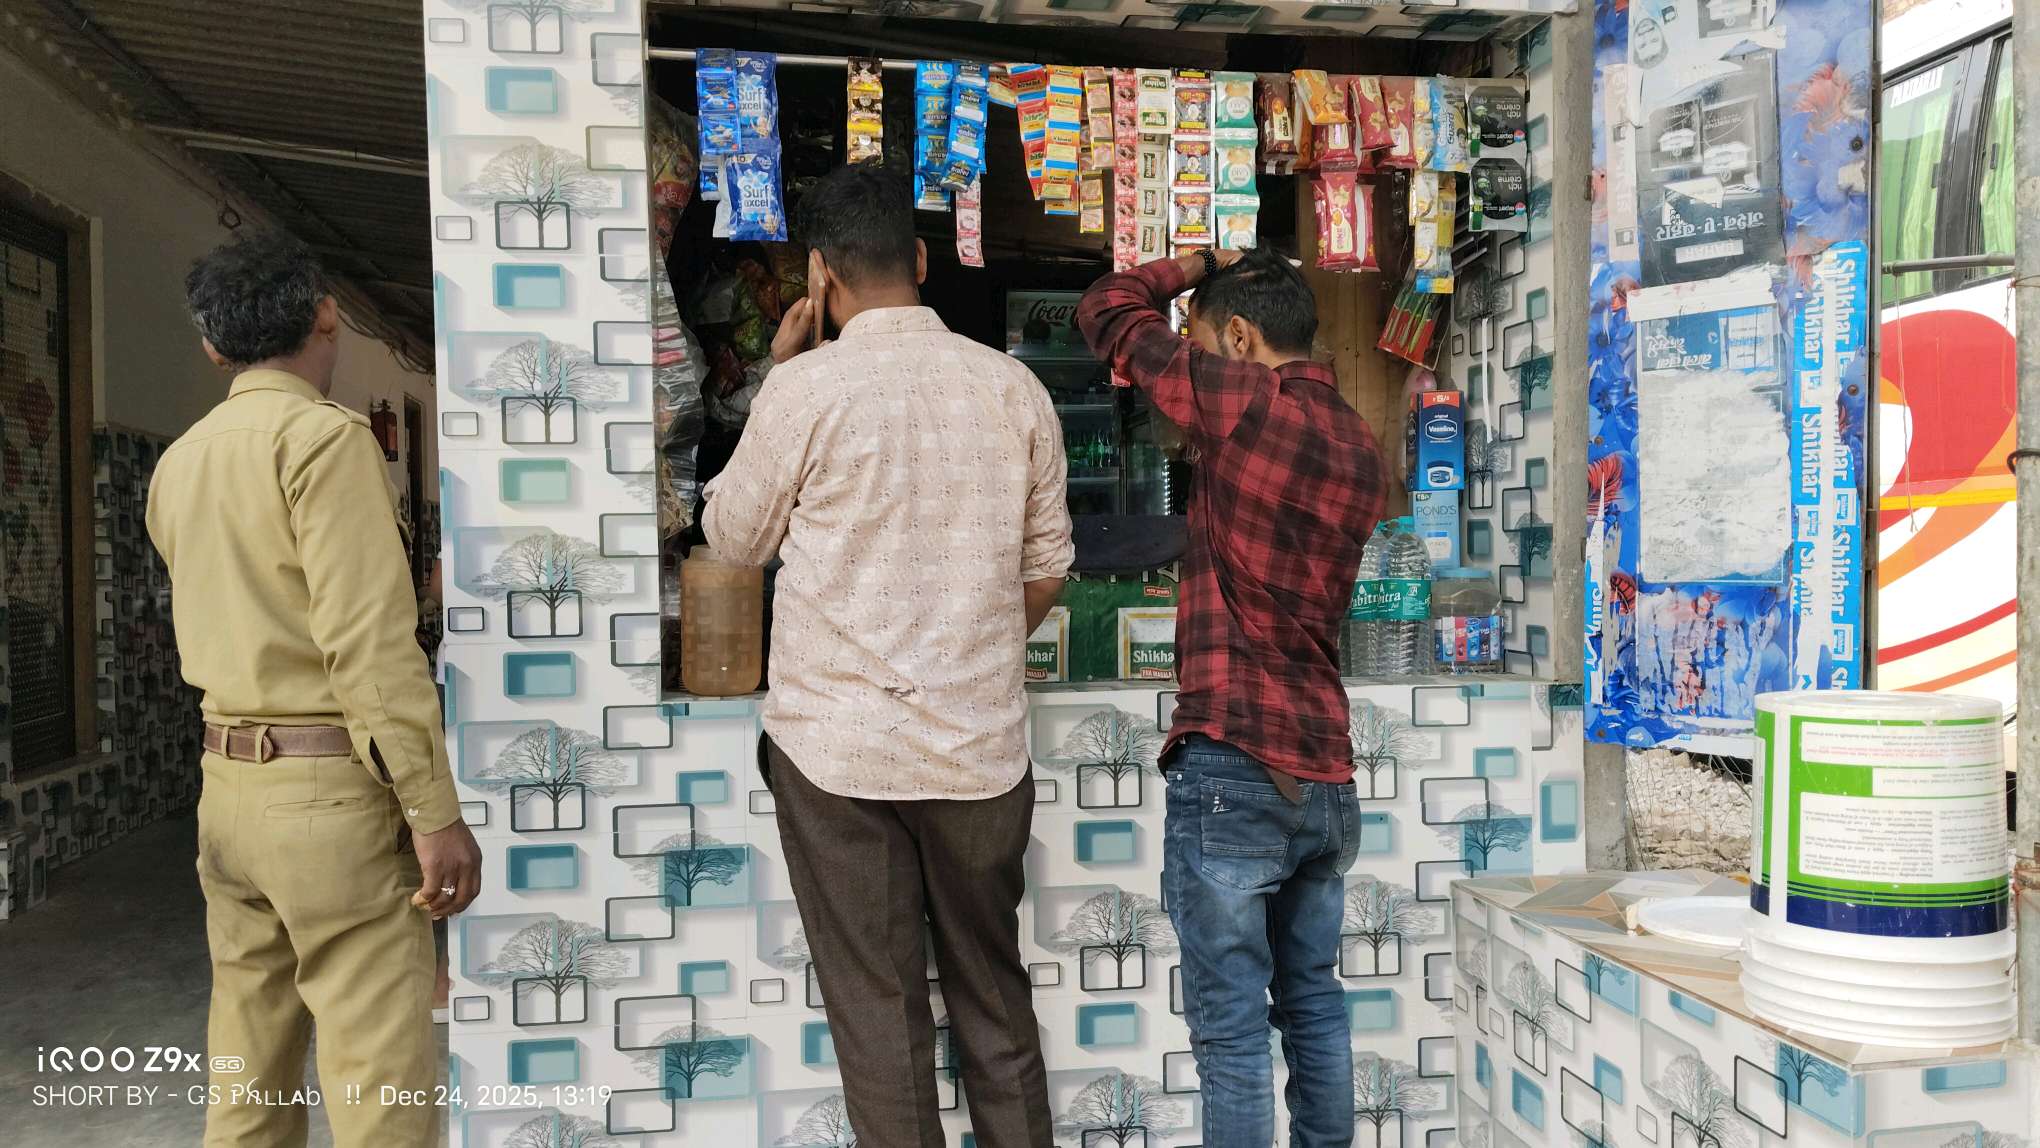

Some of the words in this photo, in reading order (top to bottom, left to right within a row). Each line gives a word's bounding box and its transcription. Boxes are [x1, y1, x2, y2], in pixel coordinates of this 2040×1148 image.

[744, 184, 768, 198] Surf
[1416, 505, 1456, 517] POND'S
[1832, 532, 1852, 617] Shikhar
[1027, 650, 1055, 662] khar
[1133, 650, 1175, 663] Shikha
